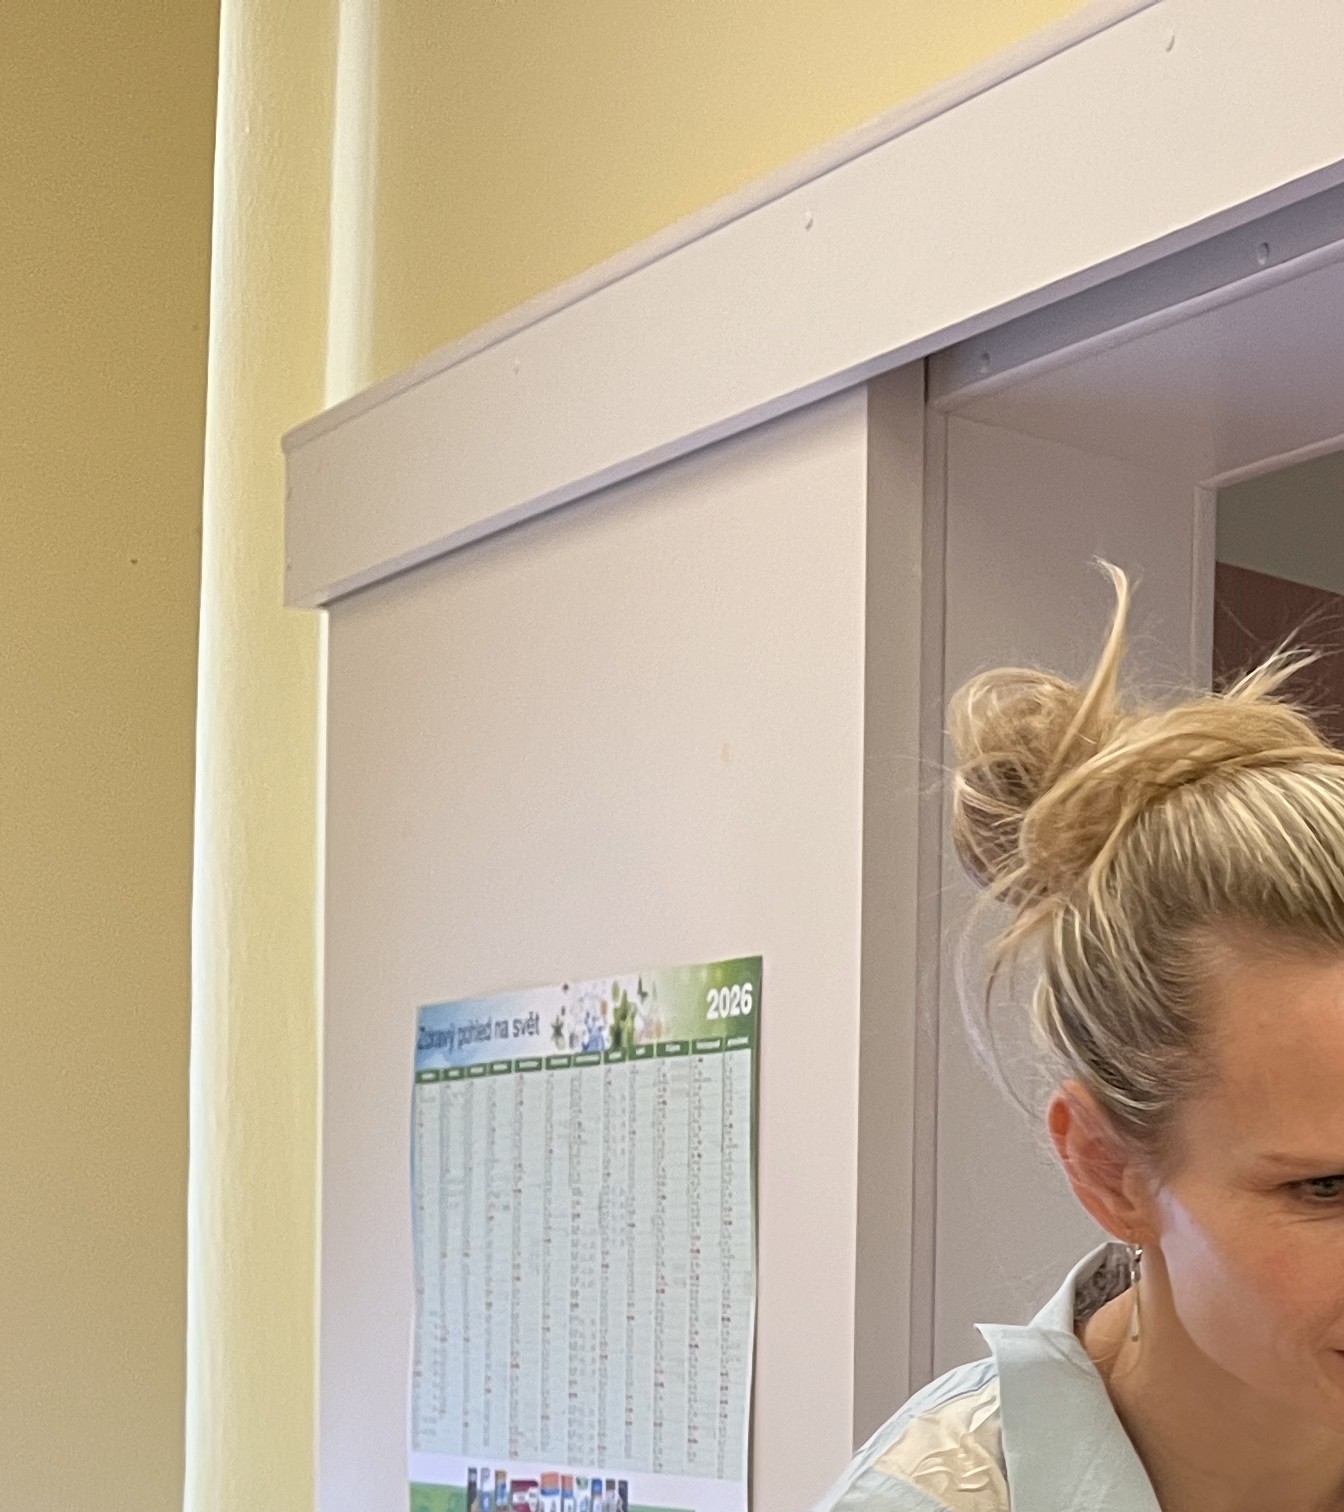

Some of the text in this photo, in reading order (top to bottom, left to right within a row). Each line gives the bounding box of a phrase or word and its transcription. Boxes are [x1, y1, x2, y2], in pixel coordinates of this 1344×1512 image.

[706, 982, 753, 1019] 2026
[494, 1020, 509, 1039] na
[512, 1010, 540, 1038] svět
